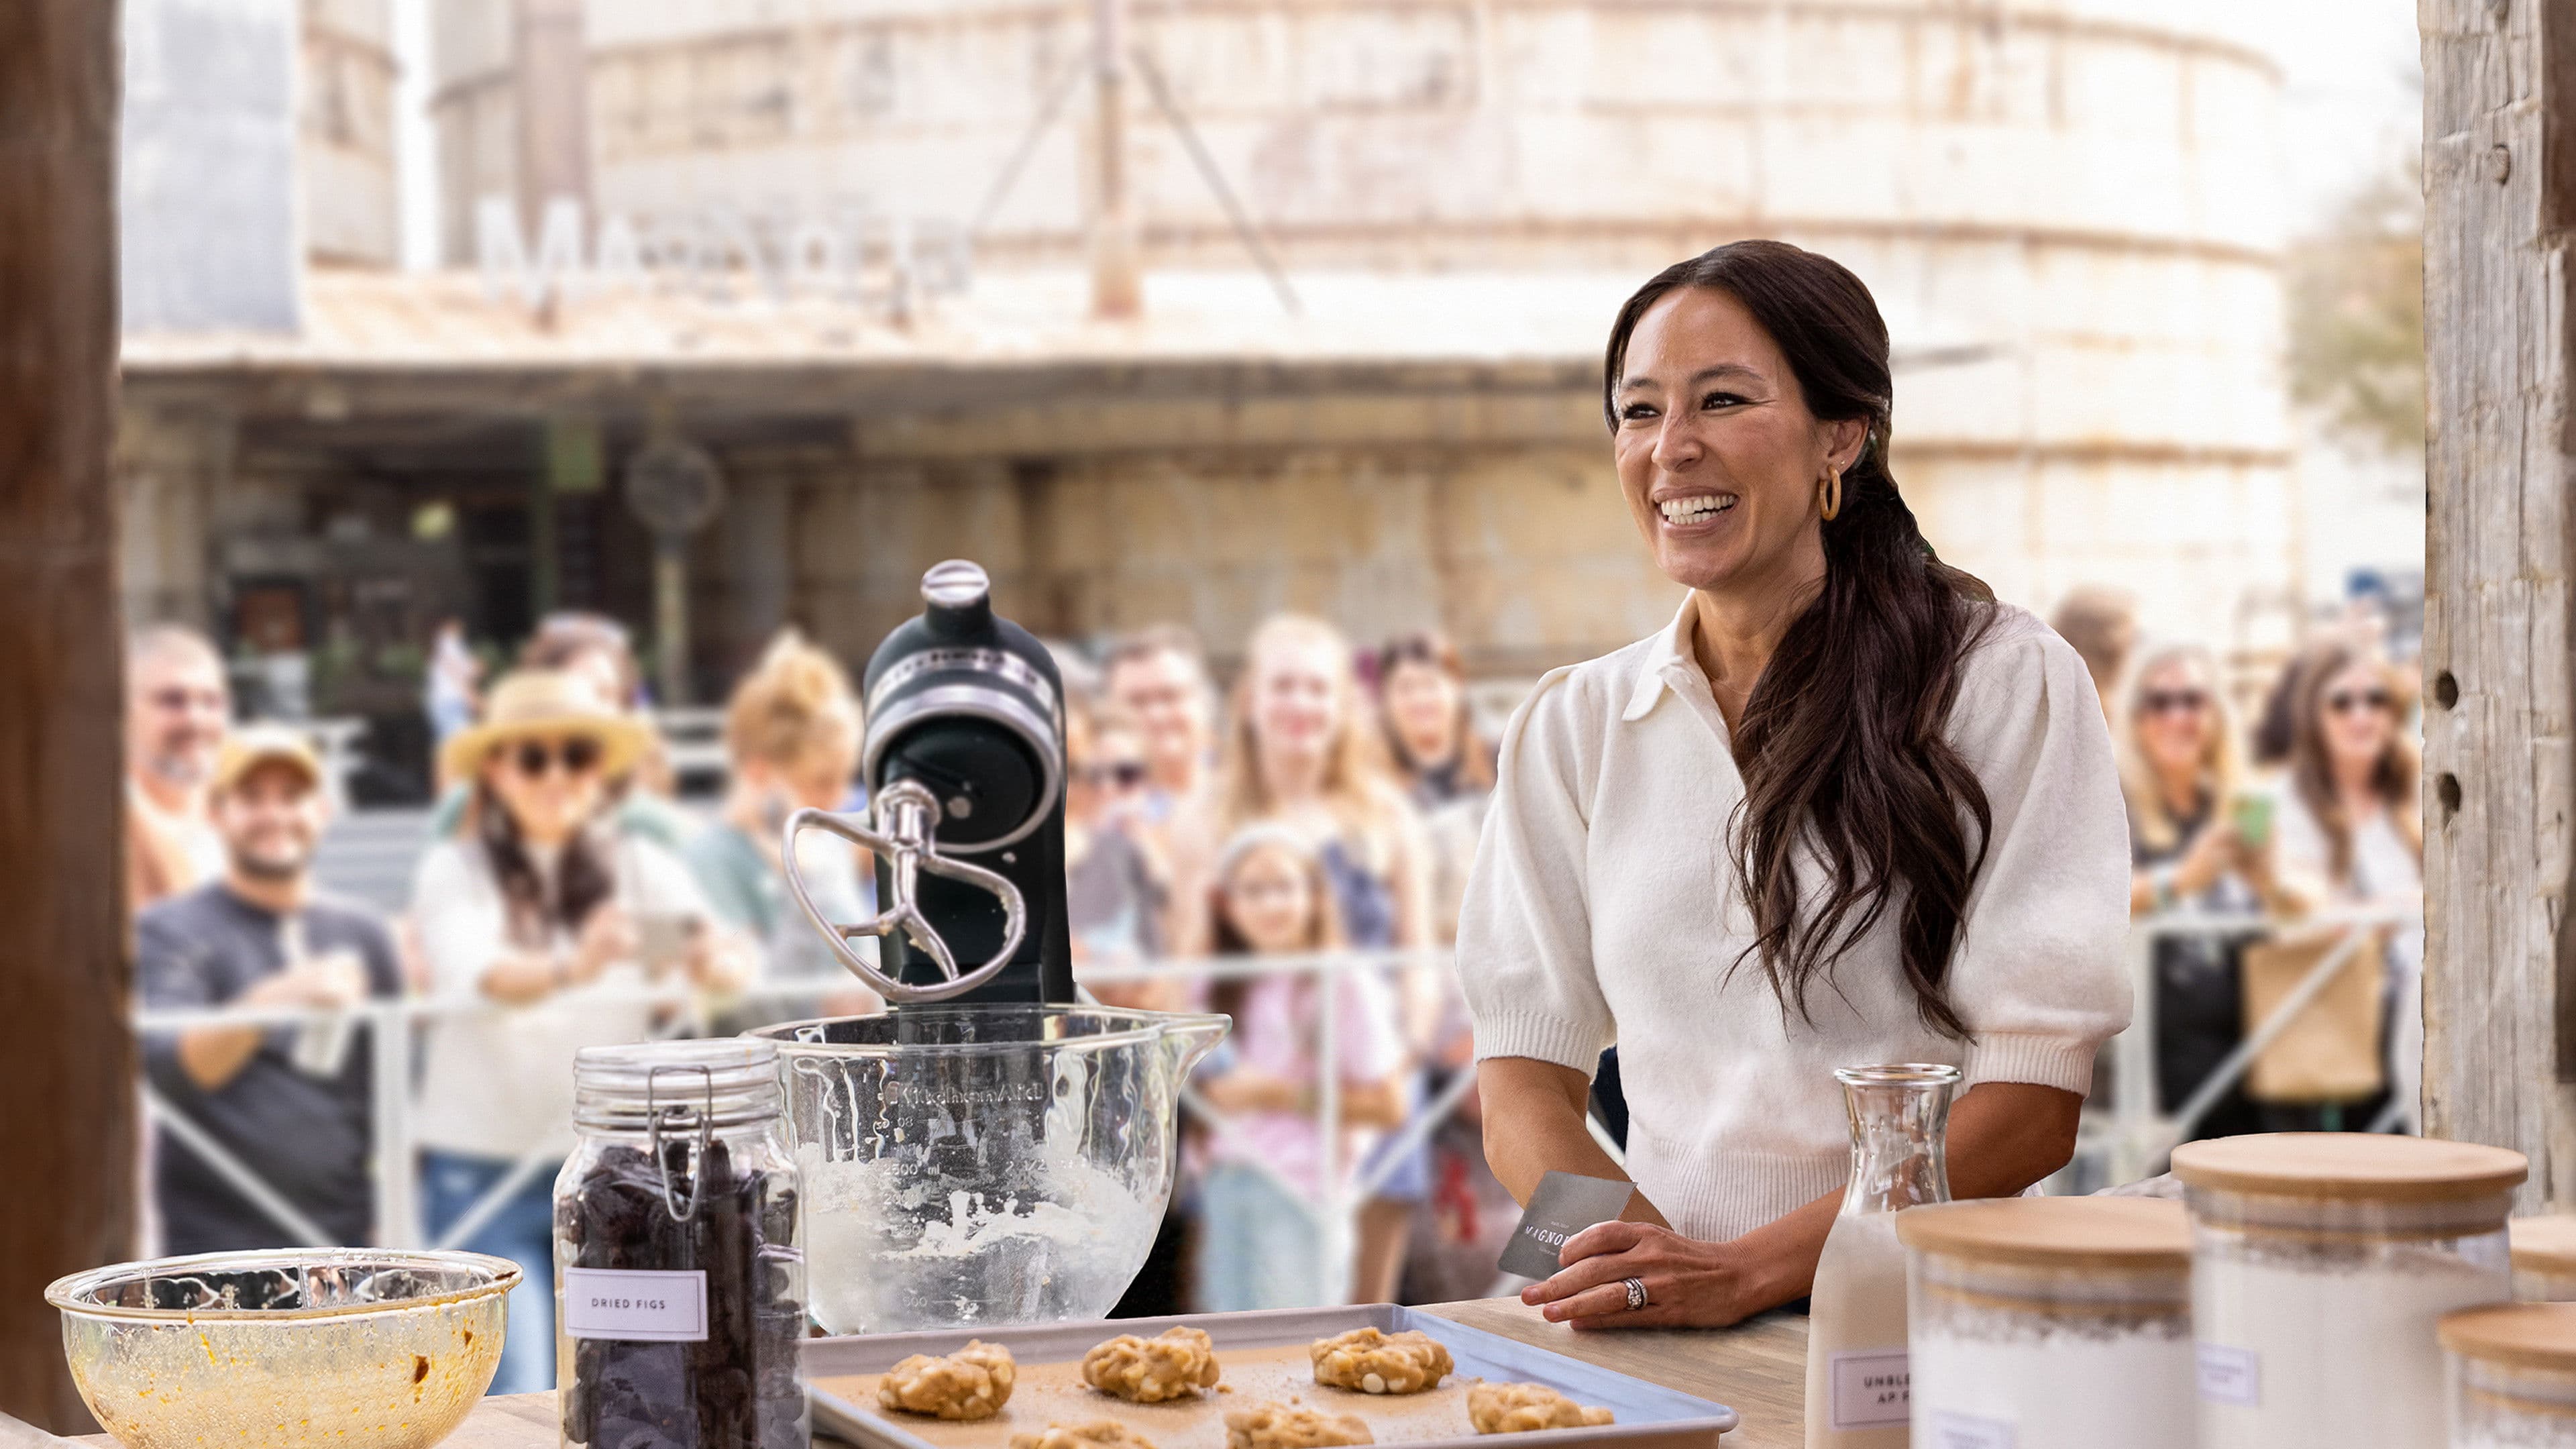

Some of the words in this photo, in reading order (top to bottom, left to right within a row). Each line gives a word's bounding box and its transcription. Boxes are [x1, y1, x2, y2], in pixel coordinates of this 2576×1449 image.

[883, 1163, 918, 1175] 2500
[927, 1164, 940, 1175] ml
[590, 1298, 631, 1309] DRIED
[637, 1299, 666, 1309] FIGS
